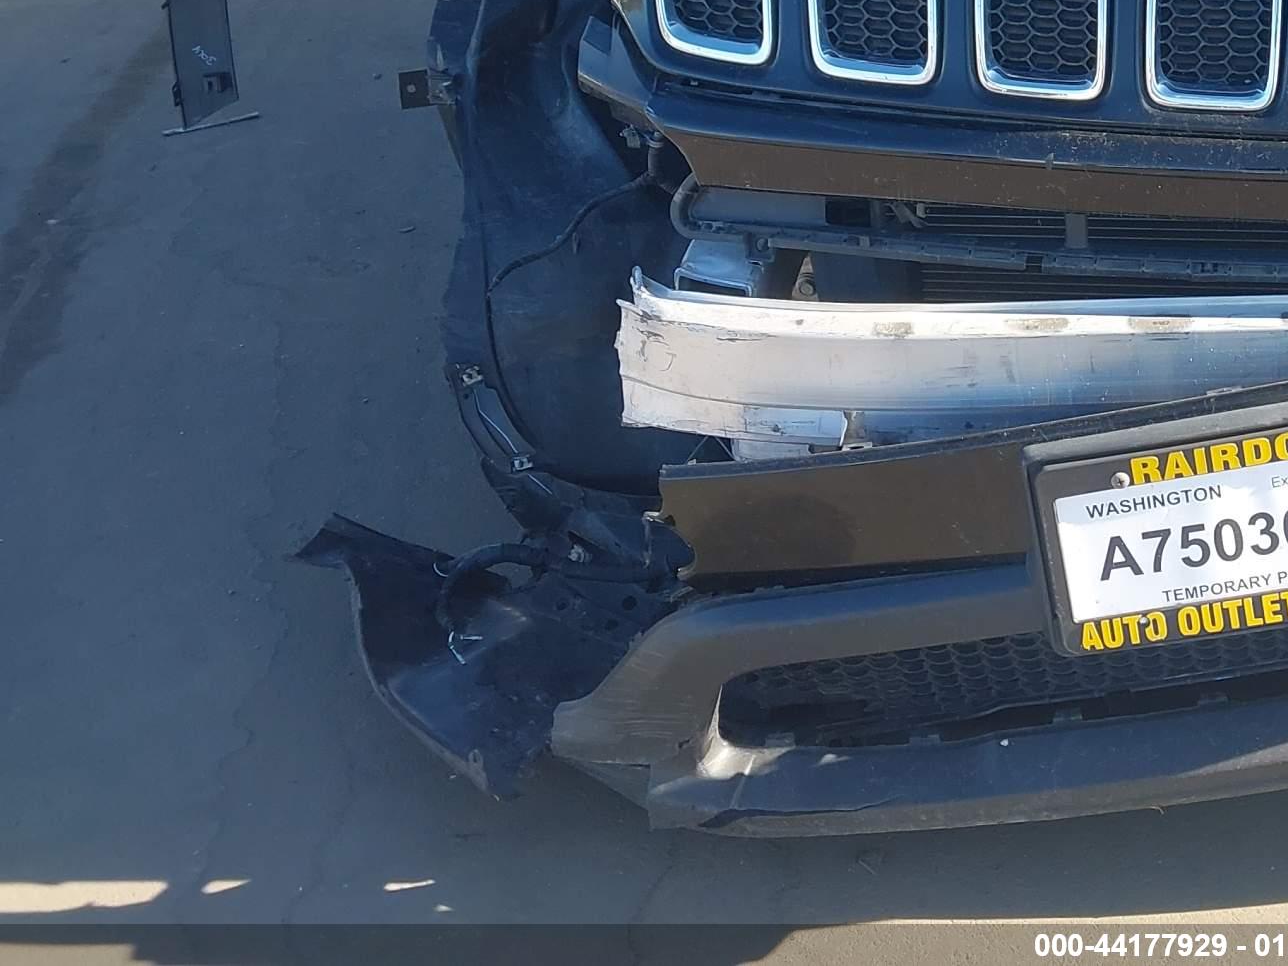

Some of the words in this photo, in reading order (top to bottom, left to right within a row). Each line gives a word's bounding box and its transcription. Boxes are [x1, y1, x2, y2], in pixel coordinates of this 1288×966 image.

[1086, 484, 1222, 519] WASHINGTON
[1162, 574, 1270, 603] TEMPORARY
[1081, 611, 1168, 651] AUTO
